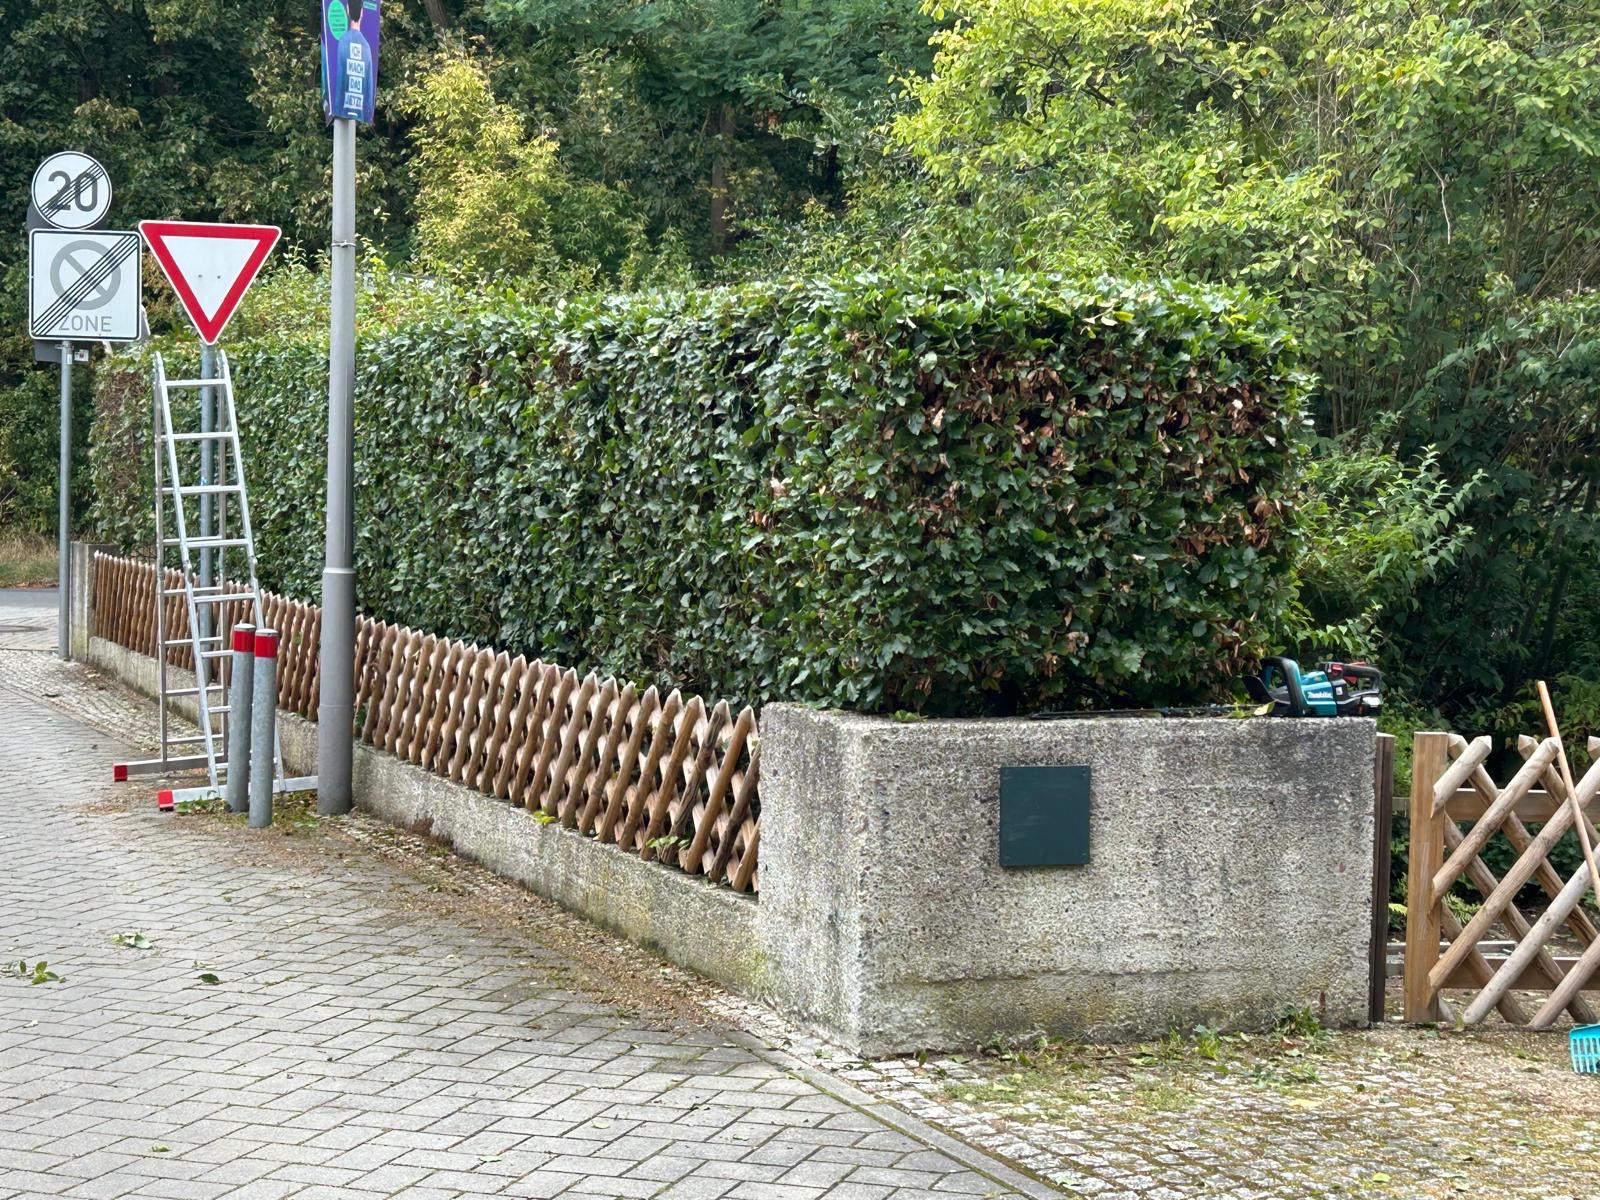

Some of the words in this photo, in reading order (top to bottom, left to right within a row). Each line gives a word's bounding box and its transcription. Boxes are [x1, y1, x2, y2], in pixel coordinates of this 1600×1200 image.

[352, 46, 361, 58] ICH
[348, 62, 364, 75] MACH
[350, 79, 361, 91] DAS
[48, 170, 98, 212] 20
[59, 315, 112, 332] ZONE
